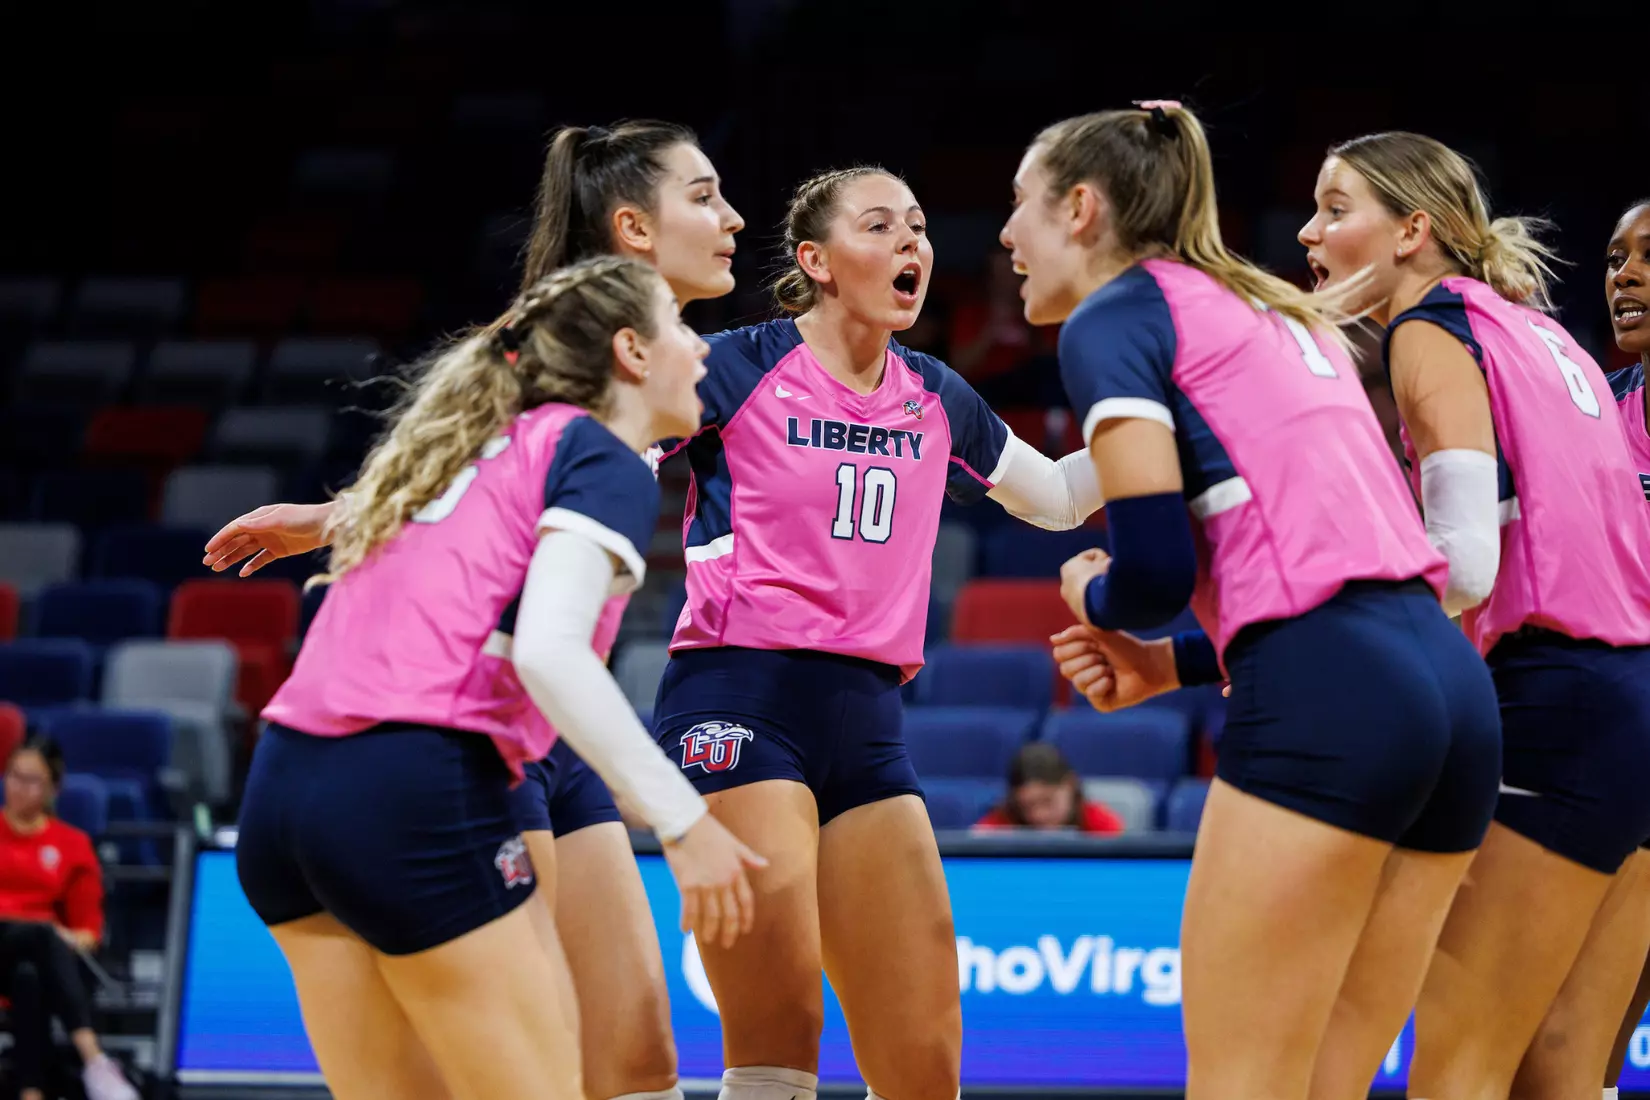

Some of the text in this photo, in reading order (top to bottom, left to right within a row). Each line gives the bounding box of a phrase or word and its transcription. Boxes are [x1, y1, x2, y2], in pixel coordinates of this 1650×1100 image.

[1525, 315, 1601, 420] 6
[787, 416, 924, 461] LIBERTY
[831, 462, 897, 544] 10
